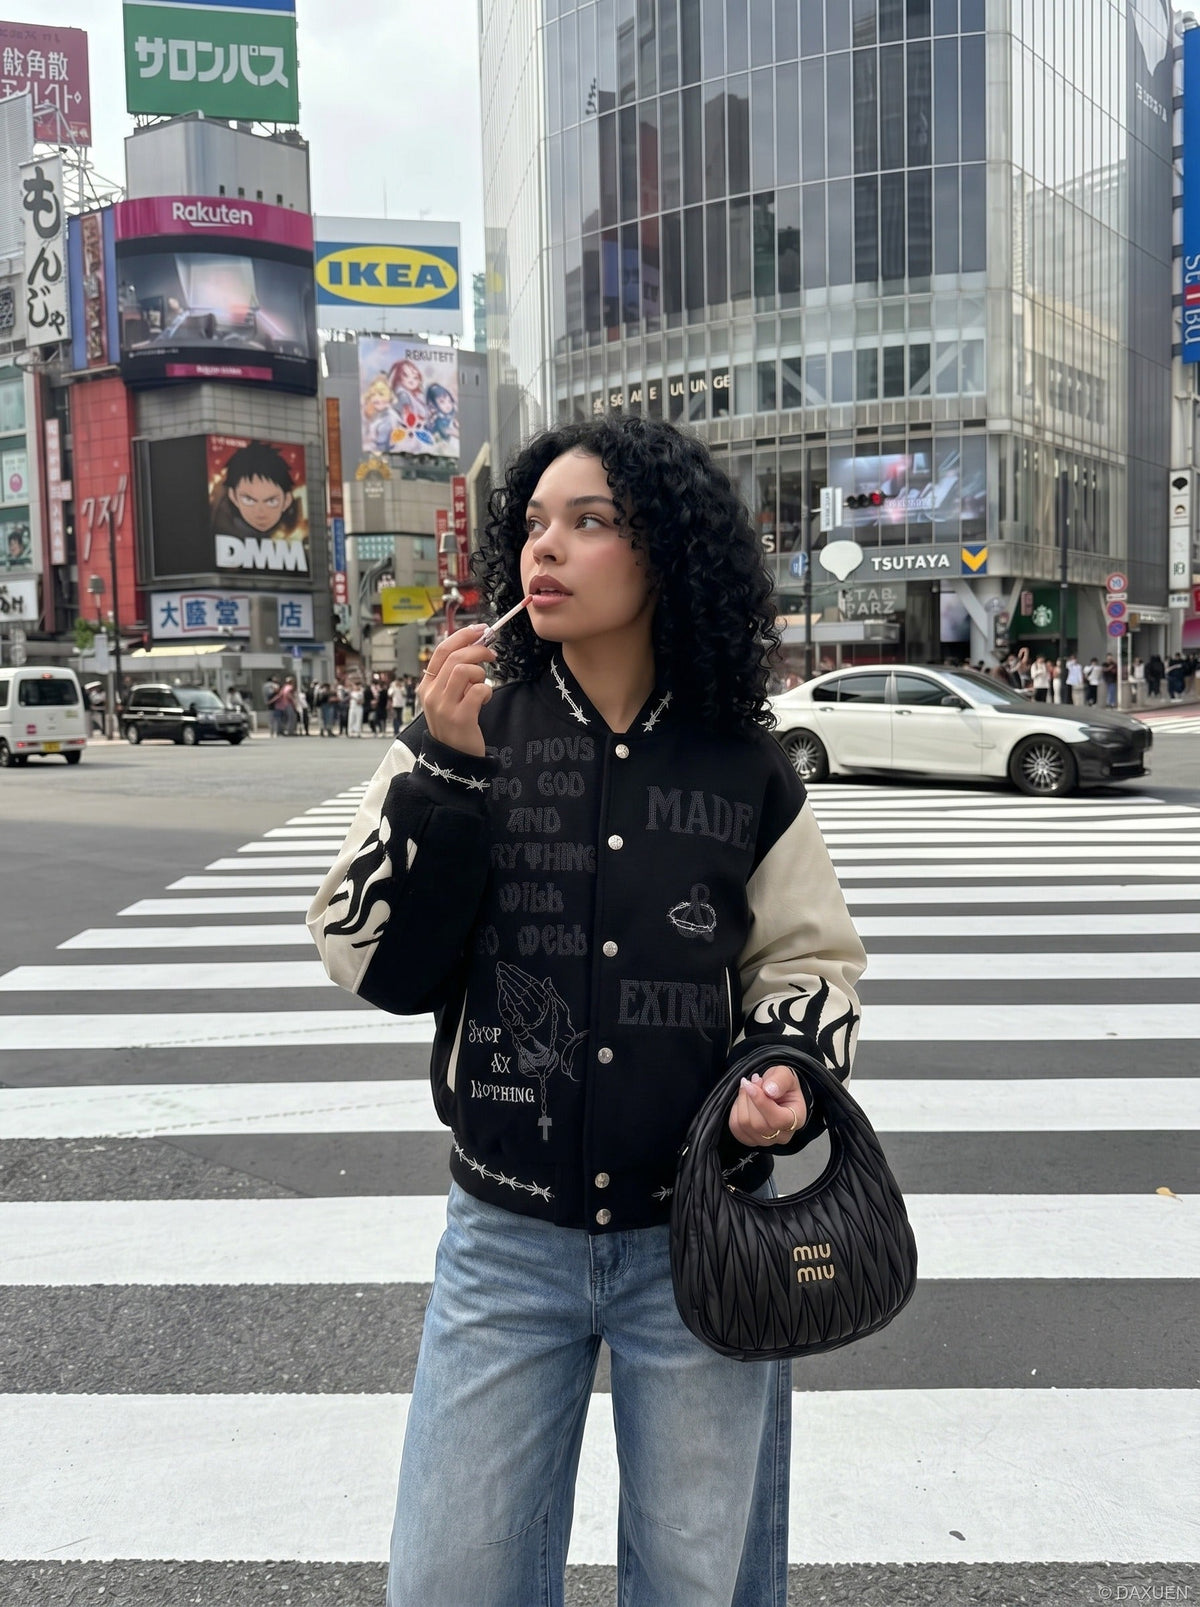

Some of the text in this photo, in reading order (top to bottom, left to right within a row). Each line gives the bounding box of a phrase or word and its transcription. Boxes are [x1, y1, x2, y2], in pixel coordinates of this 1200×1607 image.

[135, 36, 289, 88] サロンパス
[173, 202, 253, 226] Rakuten
[328, 261, 448, 289] IKEA
[215, 534, 308, 572] DMM
[872, 554, 950, 571] TSUTAYA
[537, 771, 586, 798] GOD
[506, 806, 561, 833] AND
[645, 785, 754, 849] MADE
